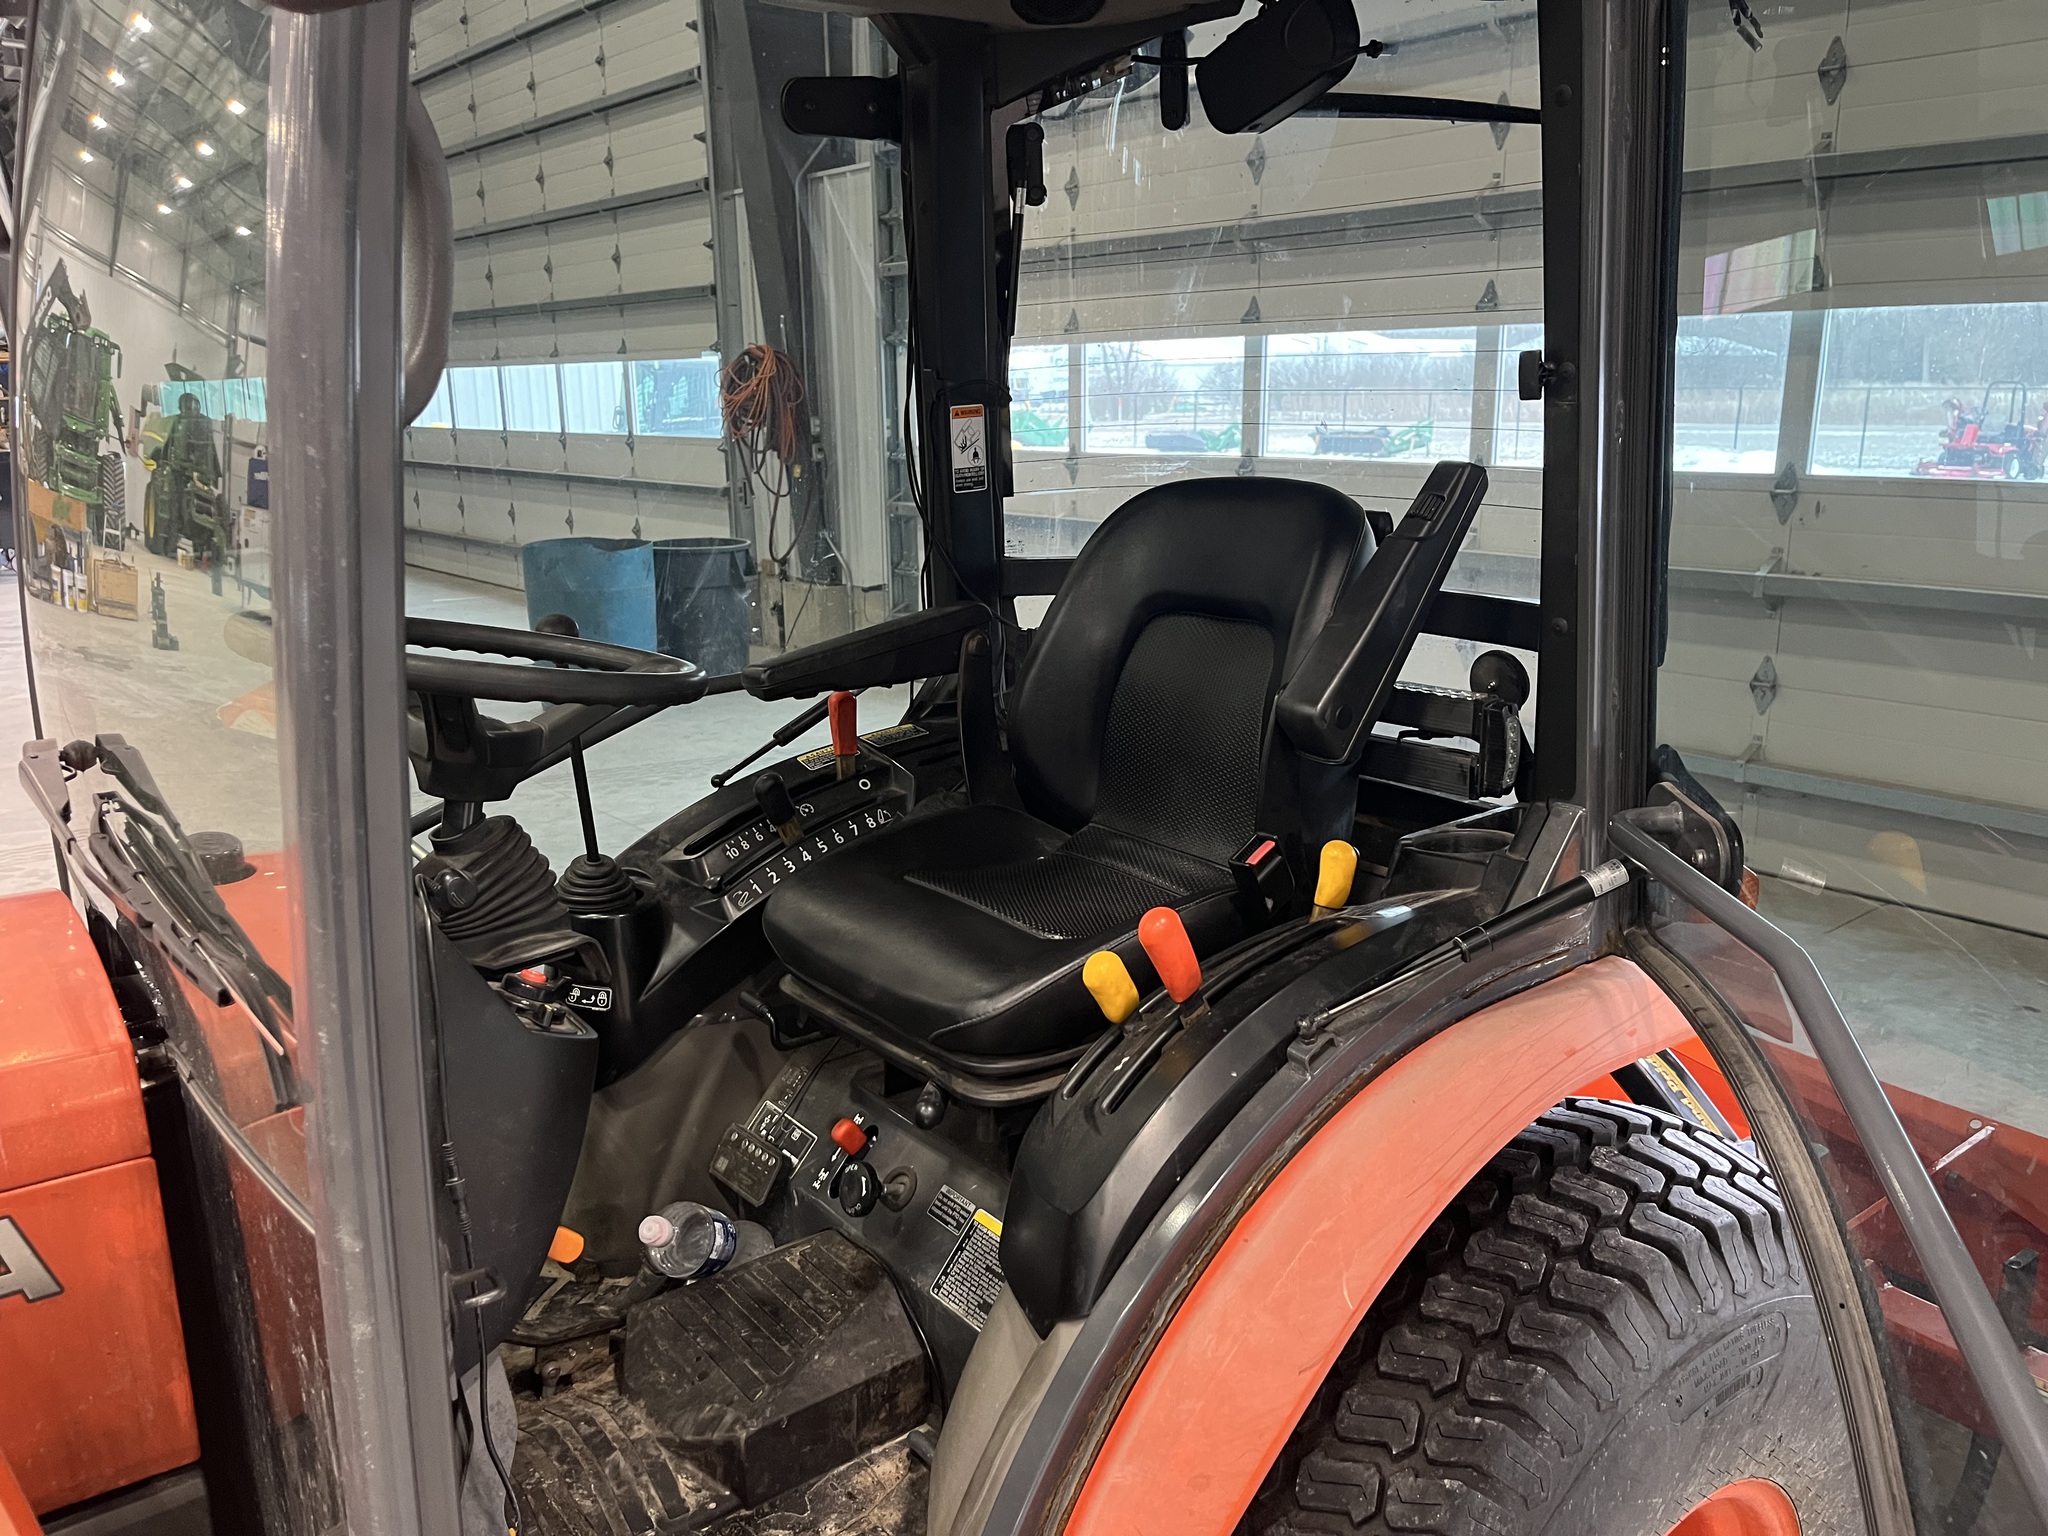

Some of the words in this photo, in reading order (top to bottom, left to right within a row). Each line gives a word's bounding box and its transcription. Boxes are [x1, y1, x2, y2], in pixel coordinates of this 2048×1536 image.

[726, 847, 740, 859] 10
[740, 840, 750, 850] 8
[755, 831, 764, 841] 6
[769, 824, 777, 833] 4
[752, 883, 762, 894] 1
[767, 871, 780, 884] 2
[784, 860, 796, 873] 3
[801, 850, 812, 862] 4
[816, 841, 828, 853] 5
[834, 832, 844, 844] 6
[848, 824, 858, 836] 7
[865, 817, 876, 828] 8
[945, 1188, 971, 1208] IMPORTANT
